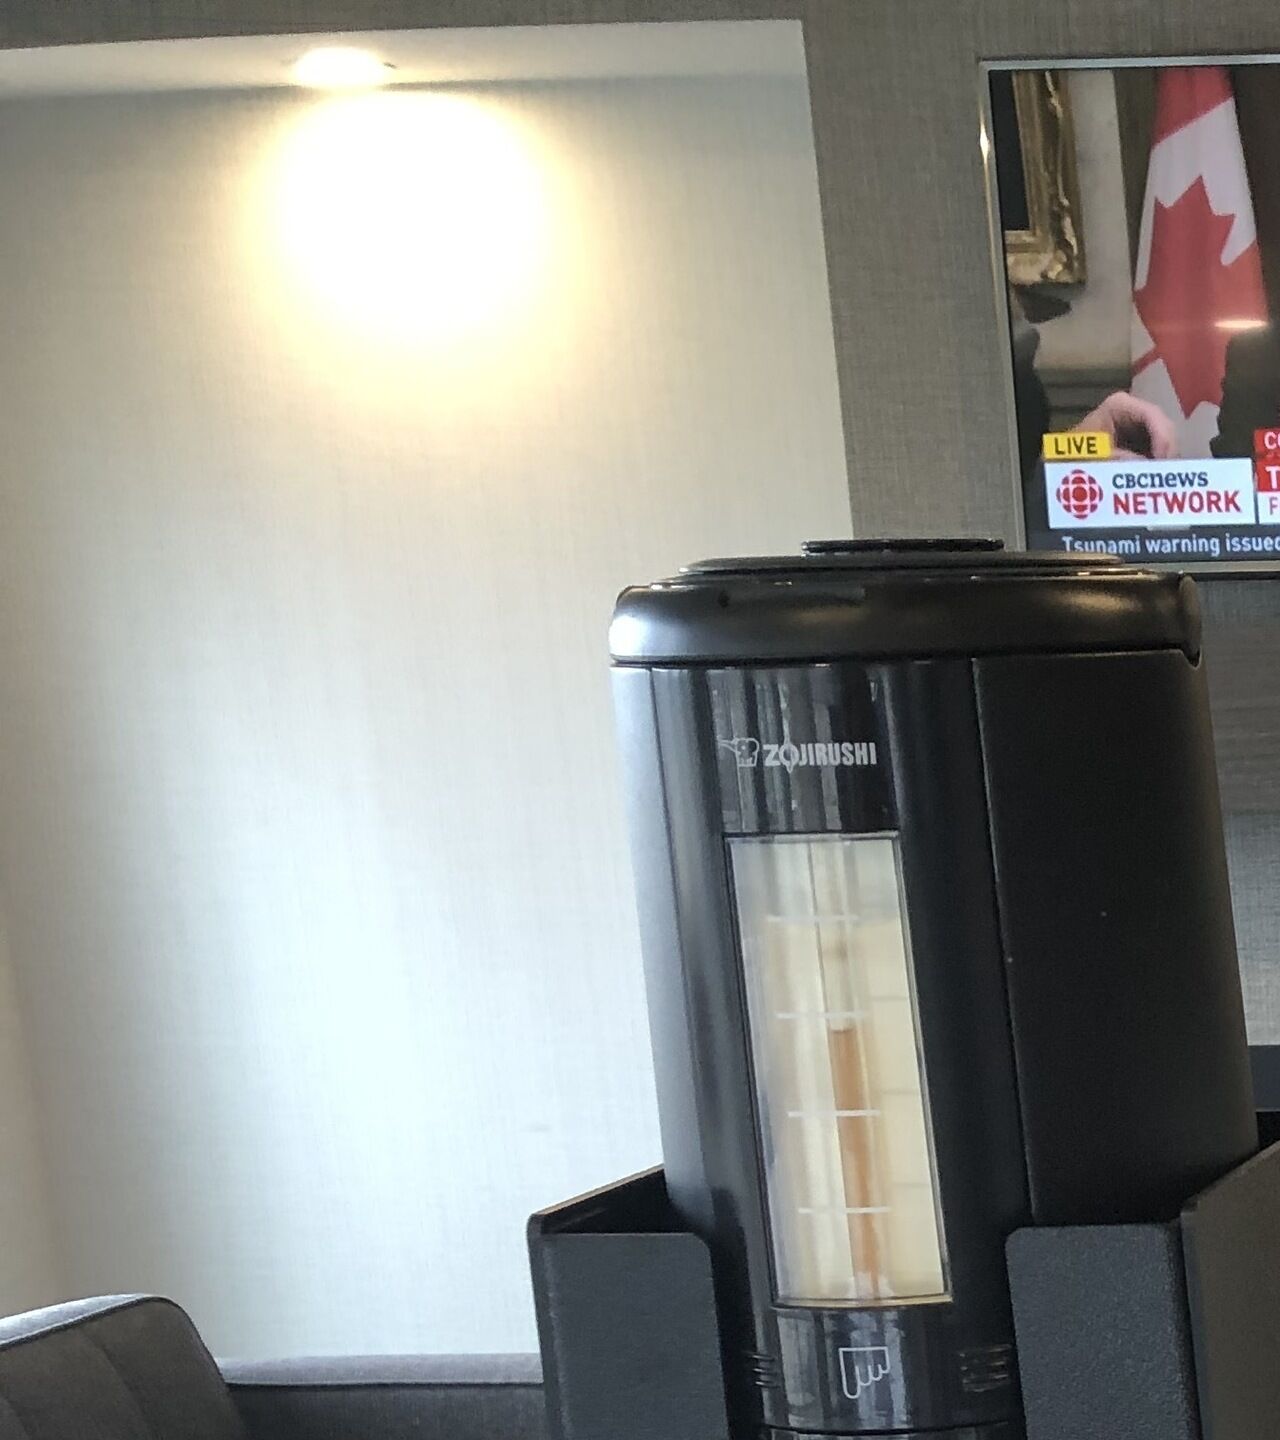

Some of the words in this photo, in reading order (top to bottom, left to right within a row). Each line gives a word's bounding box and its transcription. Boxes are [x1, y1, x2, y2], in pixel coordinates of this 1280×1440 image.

[1054, 437, 1098, 455] LIVE
[1113, 490, 1242, 515] NETWORK
[1062, 535, 1141, 554] Tsunami
[1145, 533, 1221, 558] warning
[762, 741, 878, 770] ZOJIRUSHI
